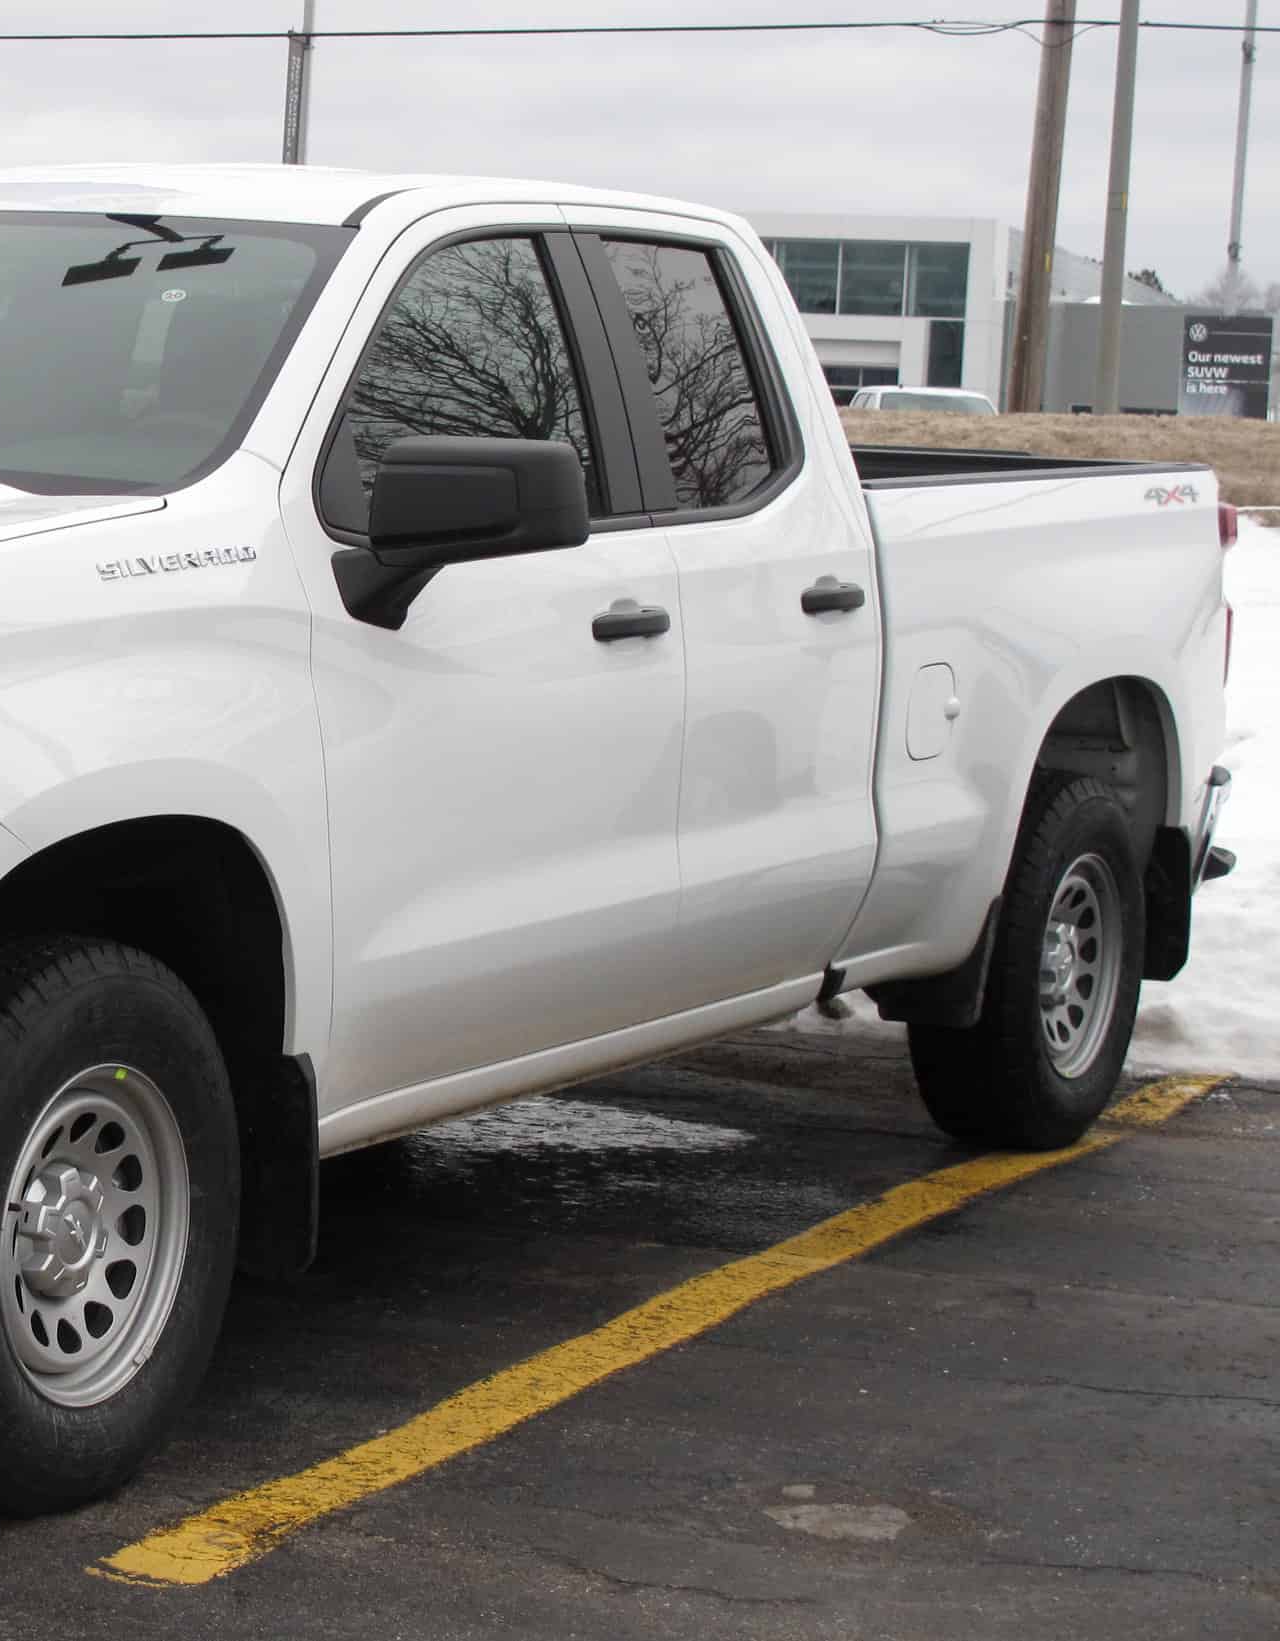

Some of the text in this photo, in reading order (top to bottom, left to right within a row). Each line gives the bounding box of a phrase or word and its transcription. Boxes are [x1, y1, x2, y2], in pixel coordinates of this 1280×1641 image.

[1188, 351, 1263, 364] Our newest
[1187, 366, 1228, 378] SUVW
[1186, 382, 1227, 394] is here
[96, 546, 256, 580] SILVERADO
